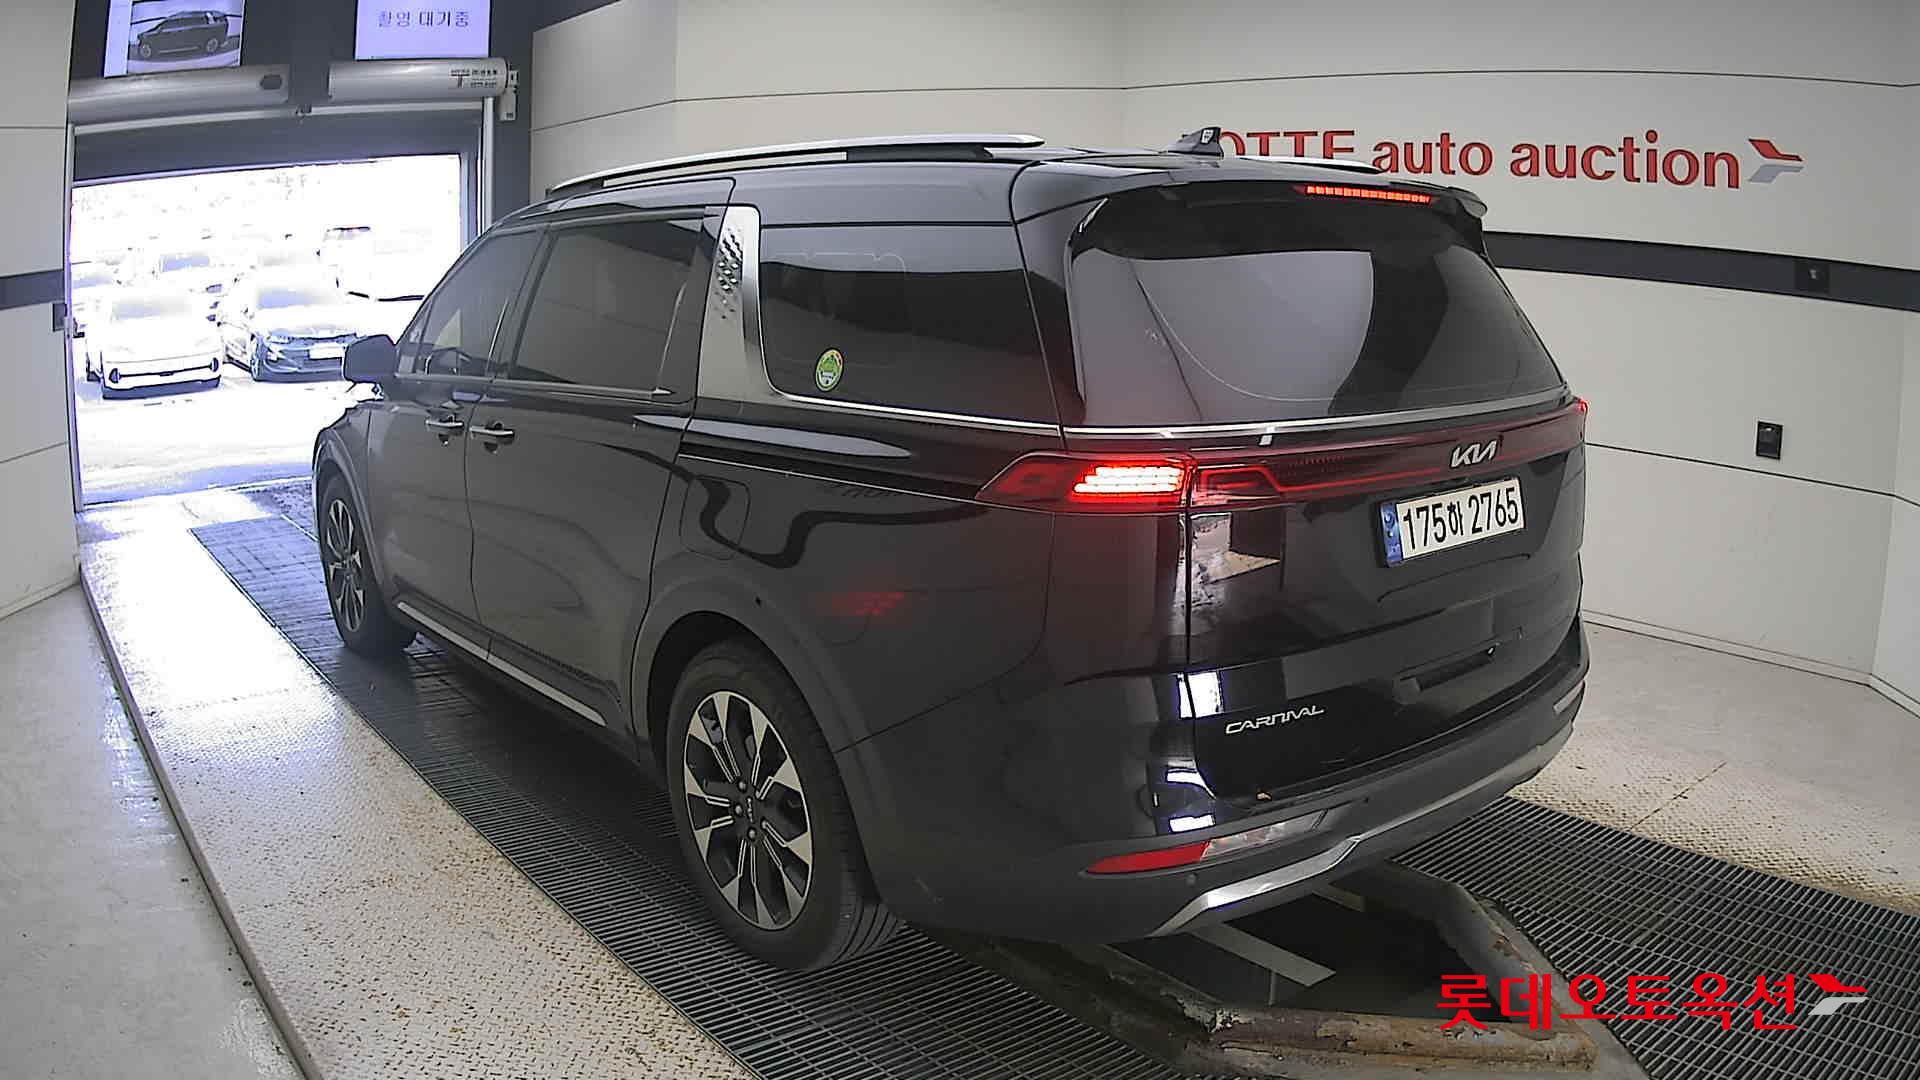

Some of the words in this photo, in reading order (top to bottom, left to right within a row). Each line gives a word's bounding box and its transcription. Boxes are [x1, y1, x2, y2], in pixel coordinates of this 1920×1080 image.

[419, 11, 469, 27] 대기중
[1219, 130, 1355, 160] TTE
[1371, 132, 1493, 176] auto
[1510, 130, 1740, 189] auction
[1403, 501, 1464, 549] 175하
[1467, 487, 1519, 535] 2765
[1225, 705, 1324, 734] CARNIVAL
